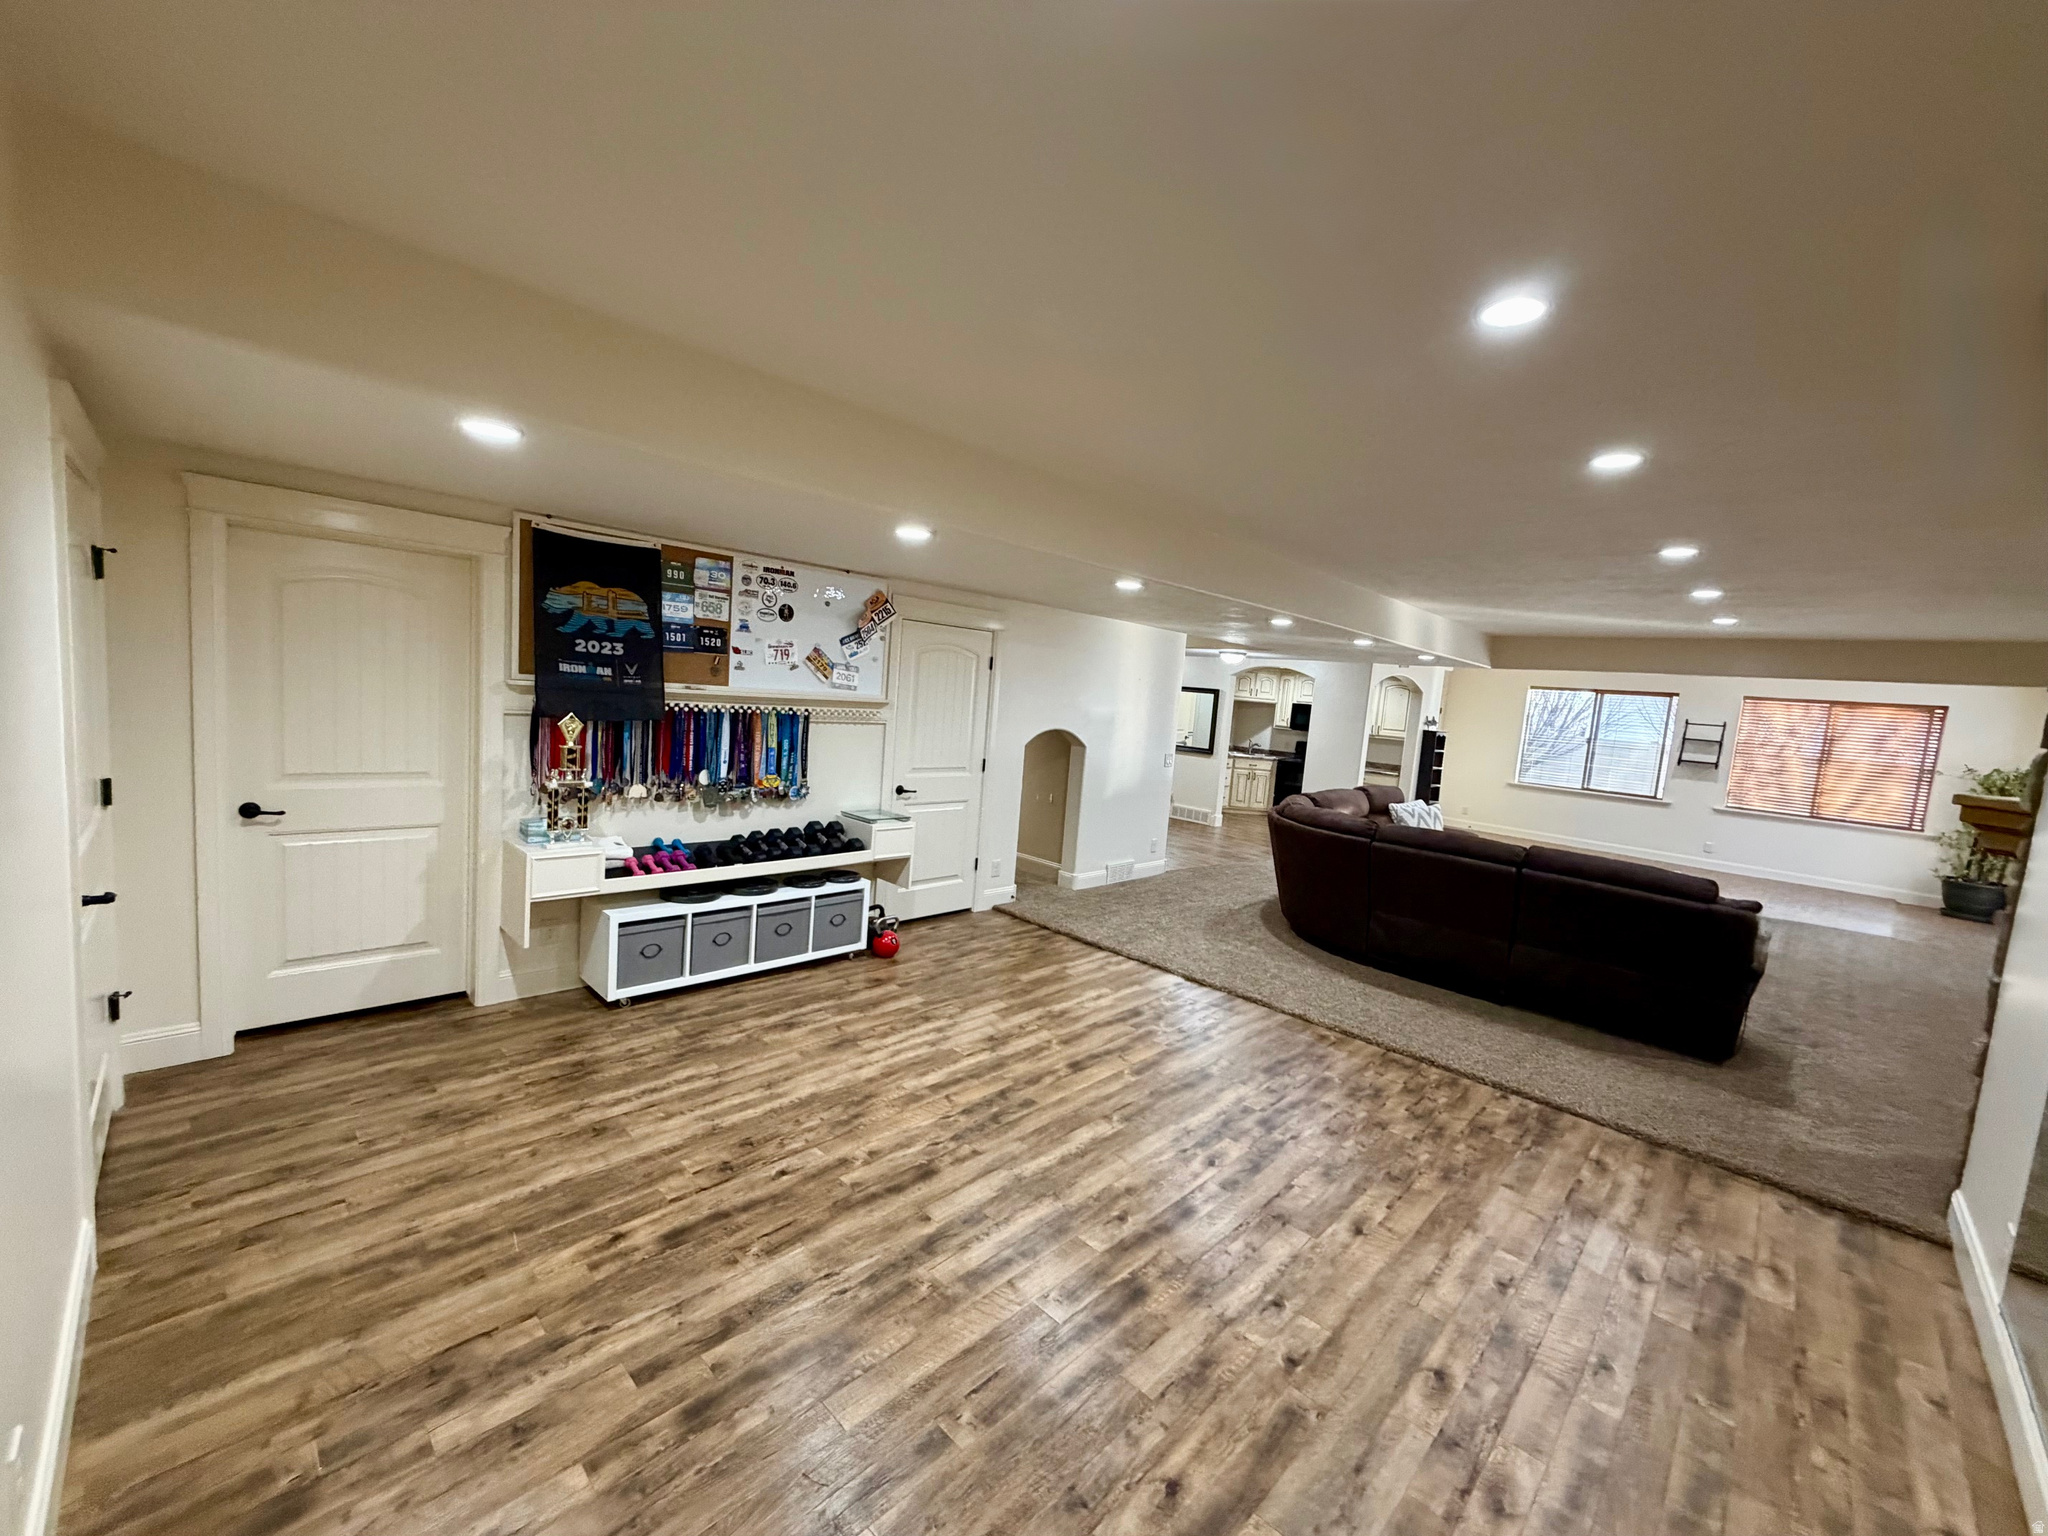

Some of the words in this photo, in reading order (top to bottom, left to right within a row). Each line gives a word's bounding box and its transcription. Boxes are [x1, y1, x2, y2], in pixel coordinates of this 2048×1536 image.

[666, 568, 685, 580] 990
[763, 565, 796, 577] IRONMAN
[759, 576, 776, 586] 70.3
[780, 580, 797, 590] 140.6
[662, 603, 689, 613] 1759
[701, 600, 723, 615] 658
[874, 605, 892, 621] 2215
[665, 632, 686, 642] 1501
[700, 636, 722, 647] 1520
[574, 639, 625, 656] 2023
[773, 648, 790, 661] 719
[836, 671, 855, 682] 2061
